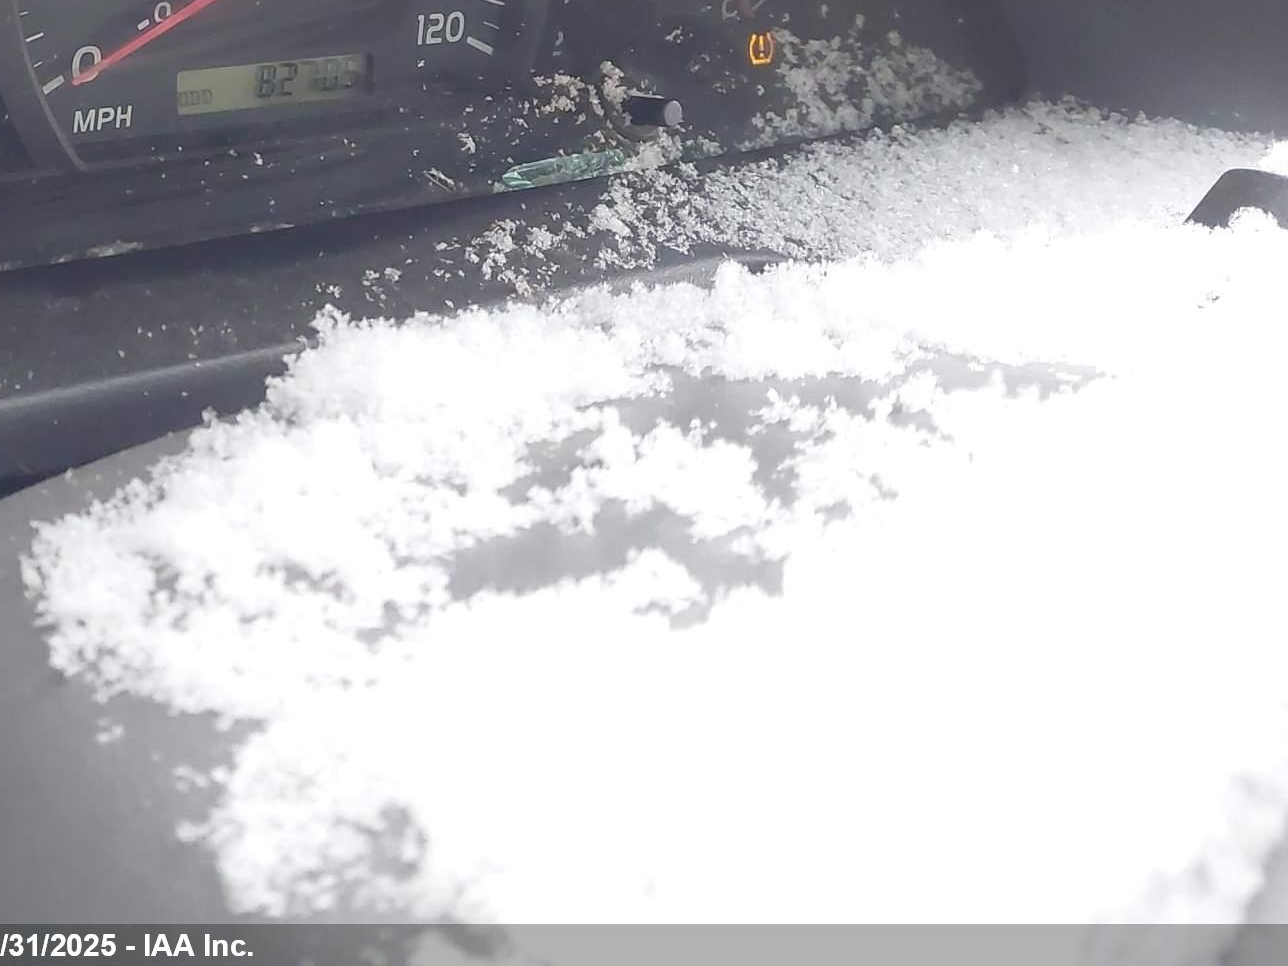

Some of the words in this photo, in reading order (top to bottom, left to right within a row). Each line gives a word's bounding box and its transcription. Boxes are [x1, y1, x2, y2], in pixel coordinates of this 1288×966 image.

[154, 1, 172, 23] 0
[418, 12, 466, 45] 120
[72, 45, 103, 82] 0
[74, 106, 131, 132] MPH
